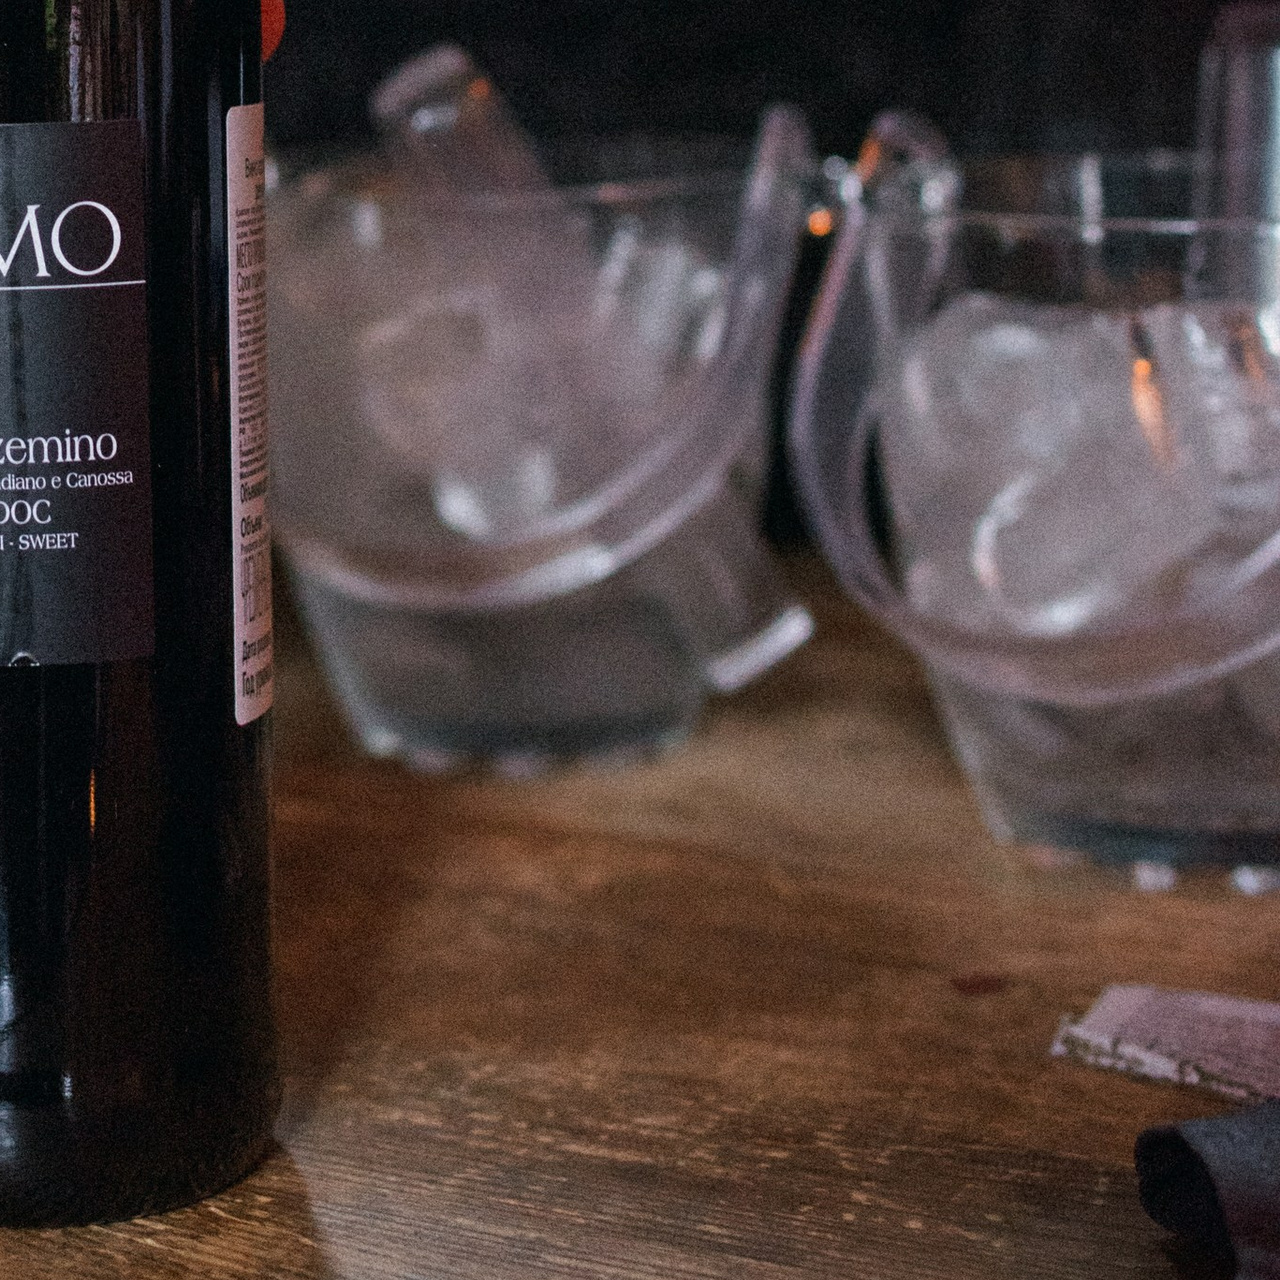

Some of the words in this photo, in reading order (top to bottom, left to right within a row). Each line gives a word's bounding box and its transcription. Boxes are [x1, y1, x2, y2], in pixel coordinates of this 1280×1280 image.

[51, 476, 61, 489] e
[66, 470, 134, 489] Canossa
[18, 532, 79, 551] SWEET
